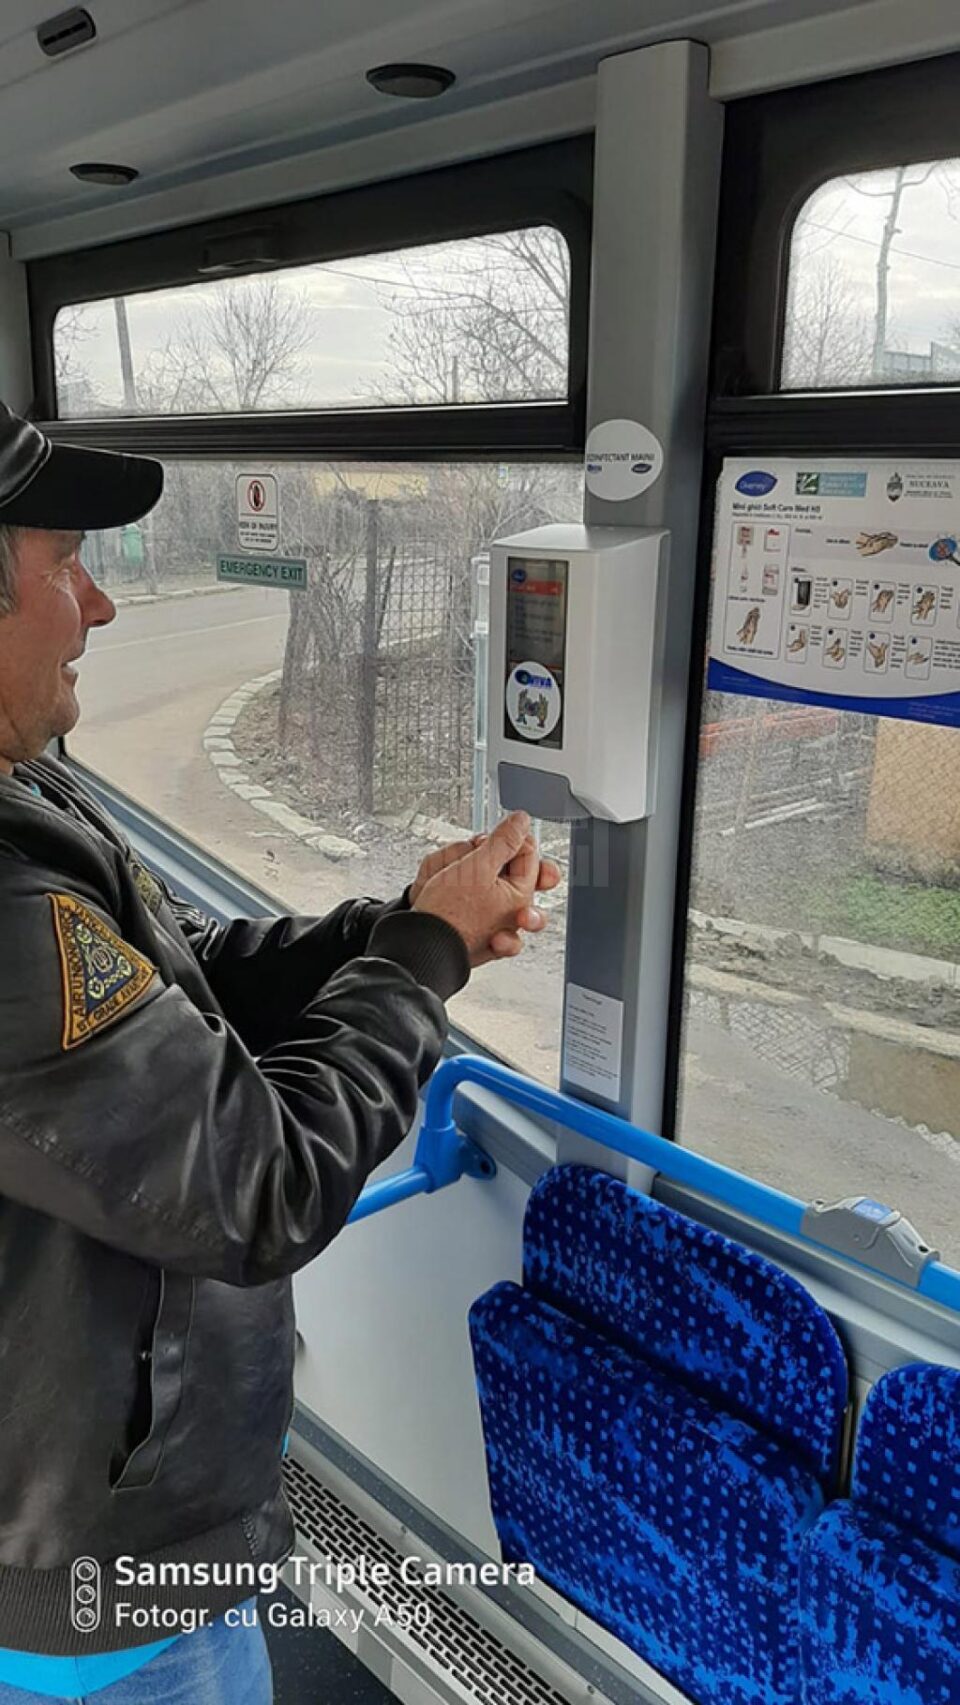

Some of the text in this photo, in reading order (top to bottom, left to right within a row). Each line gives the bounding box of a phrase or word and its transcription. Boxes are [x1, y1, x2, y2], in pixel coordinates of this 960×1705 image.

[910, 480, 949, 488] SUCEAVA
[221, 560, 303, 580] EMERGENCY EXIT
